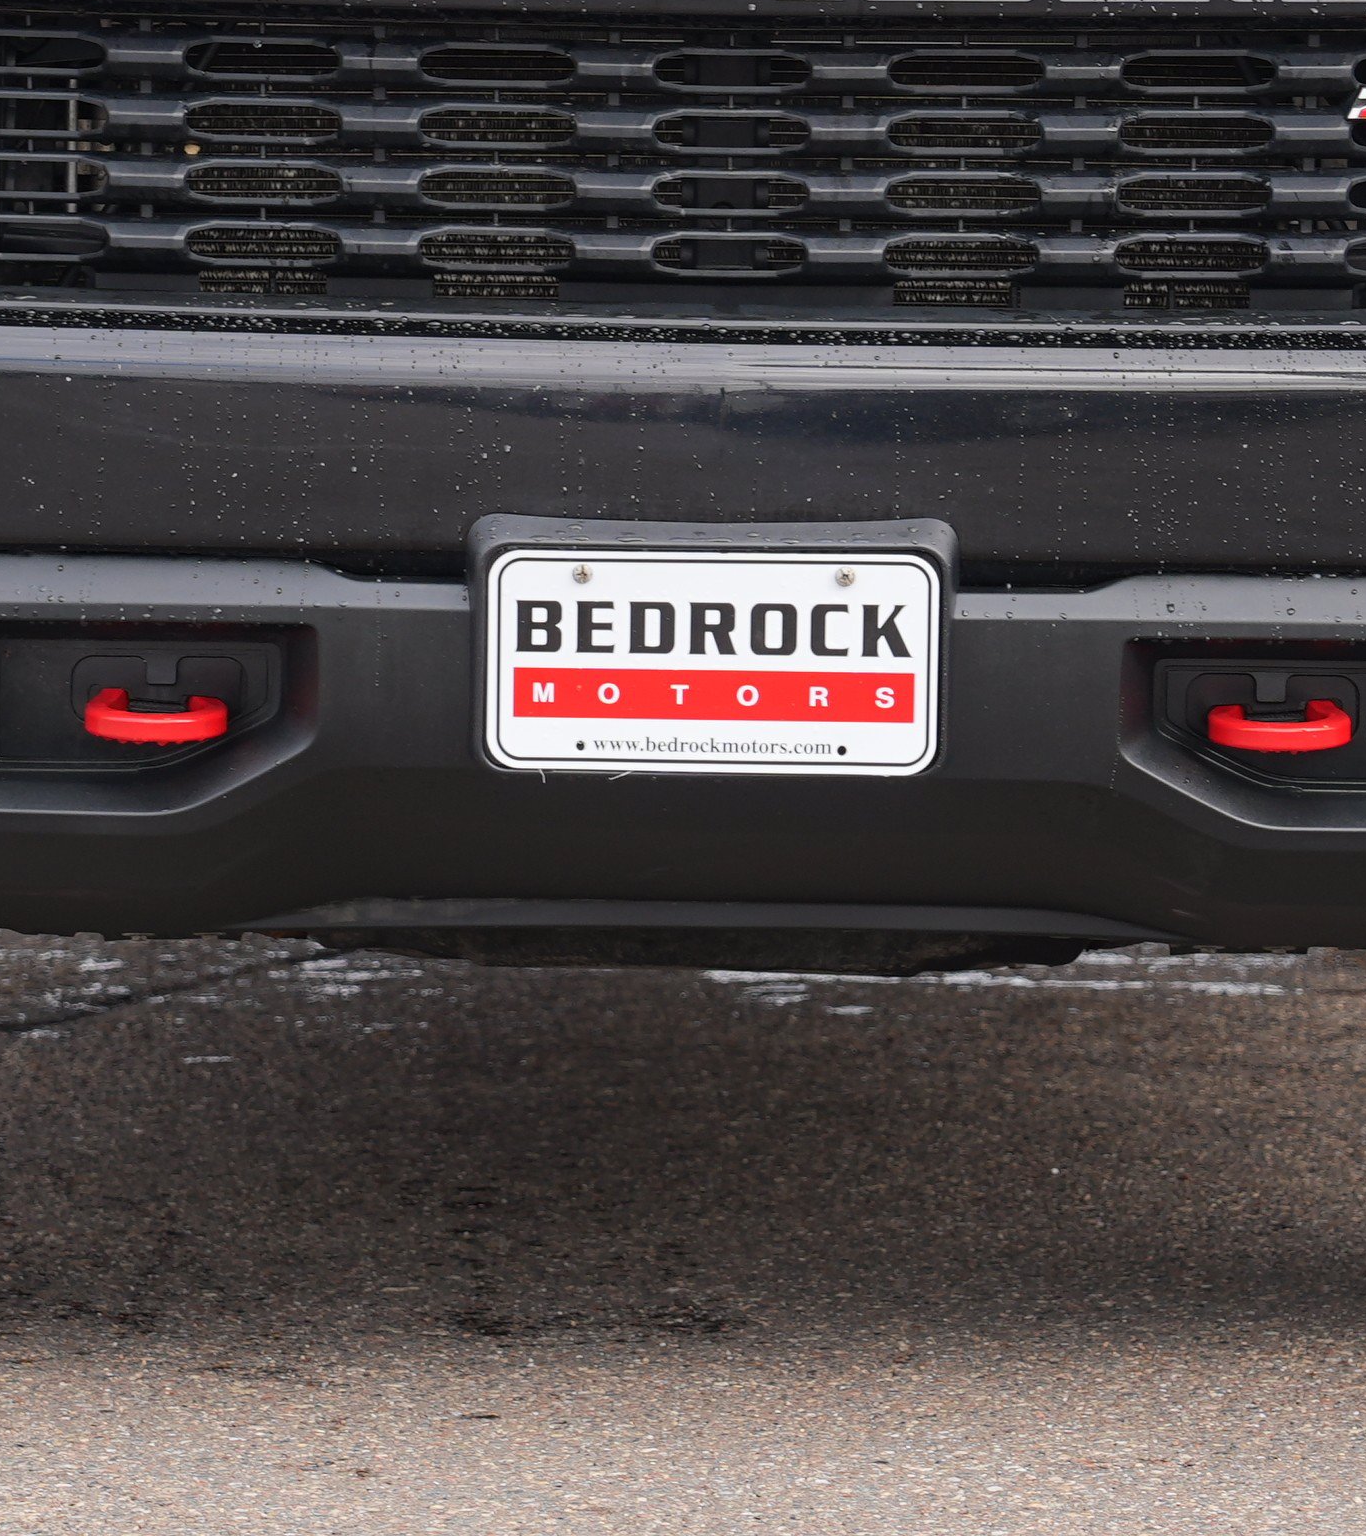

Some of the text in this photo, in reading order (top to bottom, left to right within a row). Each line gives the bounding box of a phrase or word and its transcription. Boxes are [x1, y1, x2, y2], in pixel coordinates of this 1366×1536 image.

[516, 600, 912, 657] BEDROCK
[532, 682, 895, 709] MOTORS
[594, 736, 832, 755] www.bedrockmotors.com
